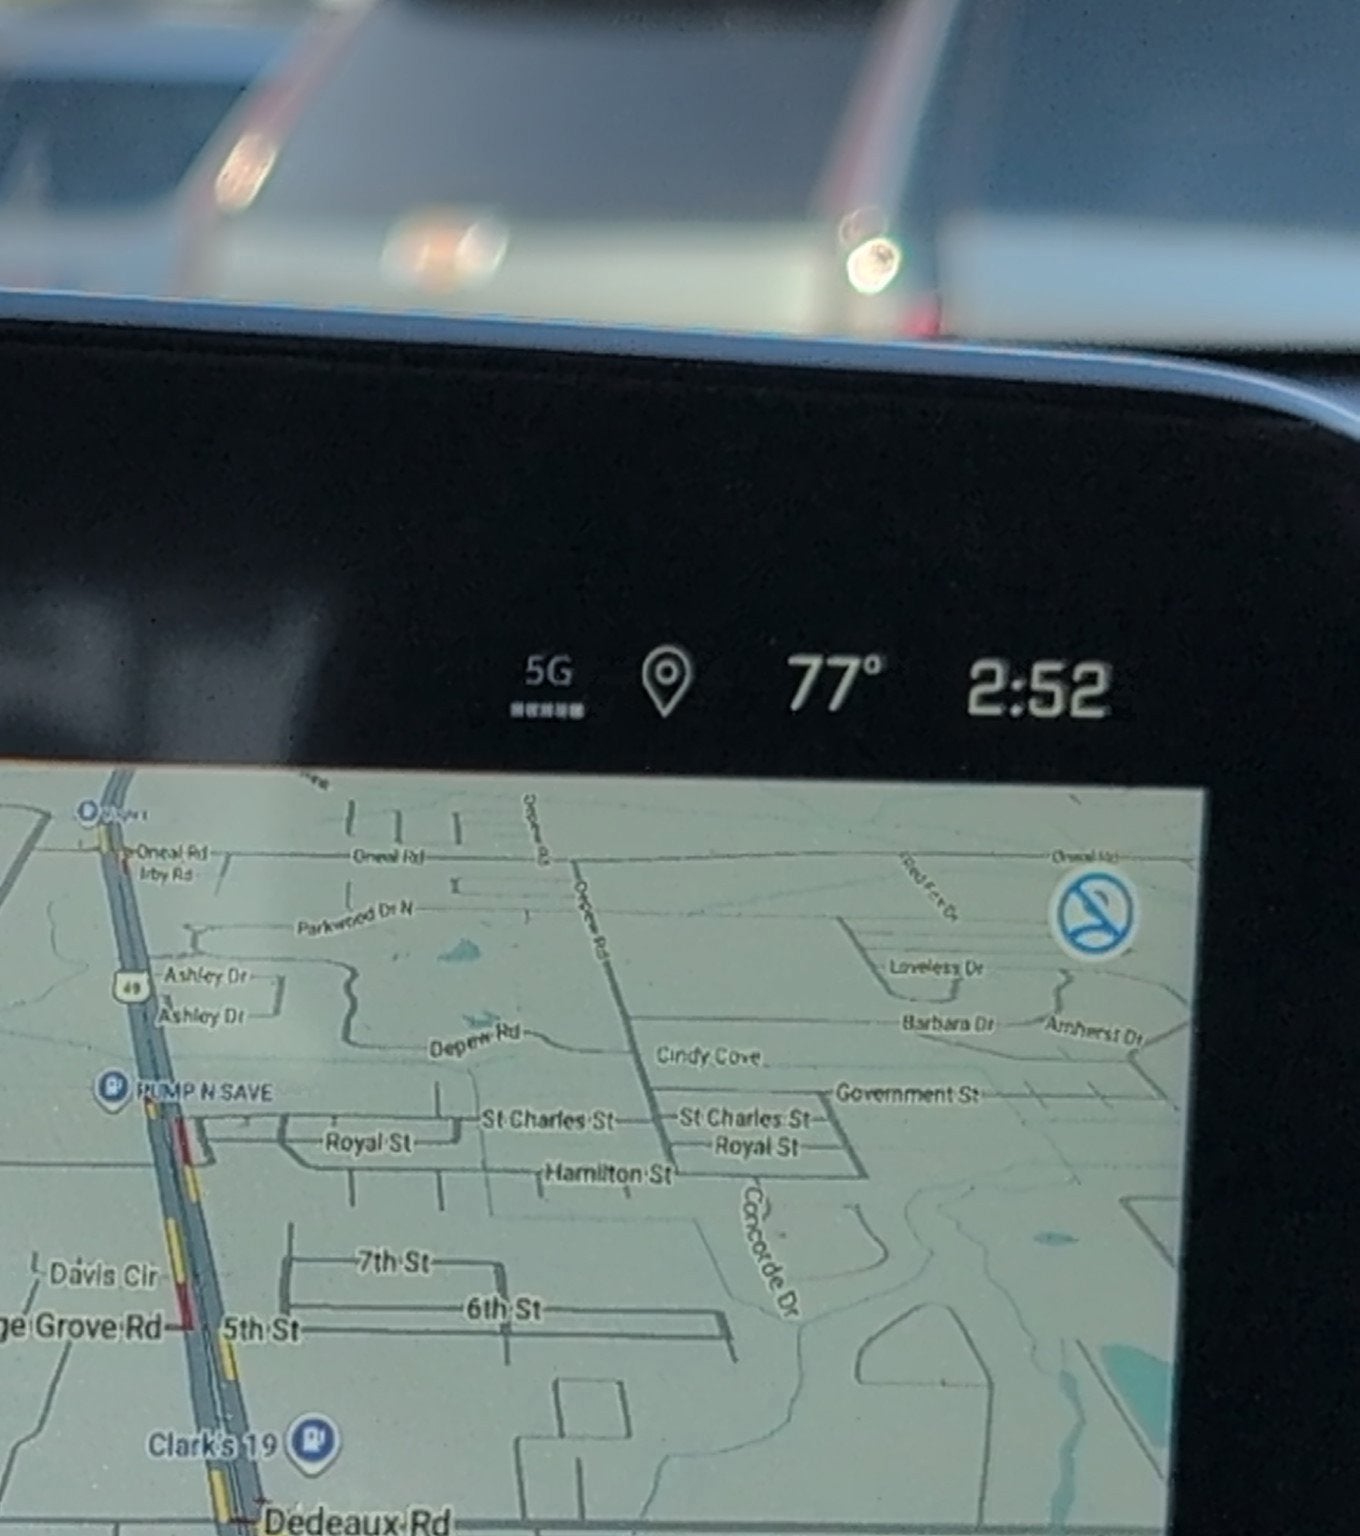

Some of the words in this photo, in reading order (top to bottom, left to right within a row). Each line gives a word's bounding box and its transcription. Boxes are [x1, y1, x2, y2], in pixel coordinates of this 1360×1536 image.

[525, 655, 573, 686] 5G
[787, 654, 885, 711] 77°
[968, 658, 1113, 718] 2:52
[297, 908, 376, 935] Parkwood
[379, 905, 397, 920] Dr
[164, 968, 223, 987] Ashley
[228, 969, 250, 985] Dr
[889, 959, 960, 976] Loveless
[965, 961, 983, 976] Dr
[123, 982, 140, 994] 49
[158, 1007, 218, 1027] Ashley
[223, 1008, 246, 1024] Dr
[902, 1014, 970, 1032] Barbara
[974, 1016, 994, 1032] Dr
[429, 1033, 492, 1059] Depew
[495, 1023, 520, 1040] Rd
[1045, 1016, 1120, 1043] Amherst
[1124, 1029, 1144, 1046] Dr
[657, 1044, 709, 1065] Cindy
[715, 1046, 761, 1064] Cove
[136, 1082, 195, 1101] PUMP
[200, 1084, 216, 1100] N
[222, 1084, 273, 1101] SAVE
[835, 1082, 954, 1103] Government
[958, 1085, 981, 1103] St
[482, 1110, 505, 1128] St
[510, 1110, 587, 1129] Charles
[593, 1112, 614, 1129] St
[680, 1109, 702, 1127] St
[707, 1110, 782, 1128] Charles
[789, 1112, 810, 1129] St
[325, 1133, 384, 1155] Royal
[388, 1134, 412, 1152] St
[714, 1136, 771, 1158] Royal
[777, 1138, 799, 1156] St
[545, 1164, 643, 1184] Hamilton
[650, 1165, 673, 1185] St
[357, 1250, 396, 1272] 7th
[404, 1252, 429, 1273] St
[743, 1186, 784, 1290] Concorde
[777, 1290, 800, 1318] Dr
[50, 1262, 115, 1286] Davis
[124, 1264, 158, 1286] Cir
[466, 1298, 510, 1320] 6th
[515, 1299, 541, 1321] St
[36, 1312, 117, 1340] Grove
[125, 1314, 162, 1340] Rd
[222, 1317, 264, 1341] 5th
[270, 1318, 300, 1342] St
[148, 1432, 235, 1458] Clark's
[245, 1433, 277, 1458] 19
[264, 1506, 400, 1536] Dedeaux
